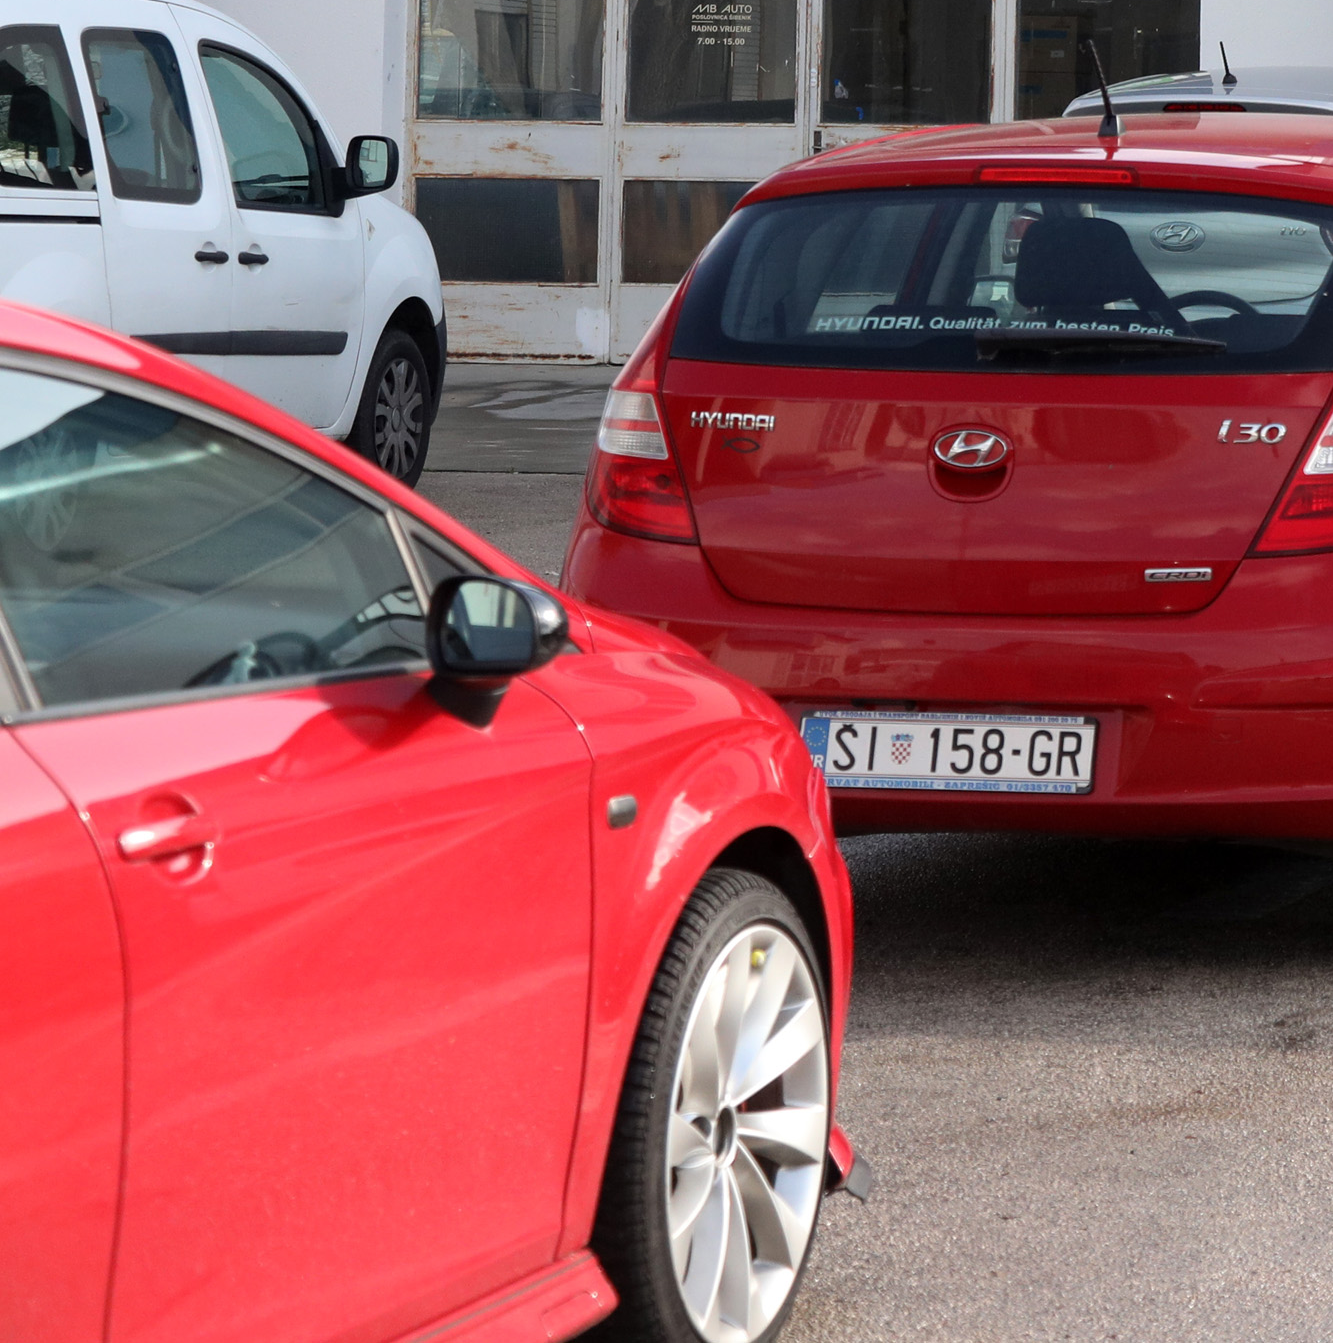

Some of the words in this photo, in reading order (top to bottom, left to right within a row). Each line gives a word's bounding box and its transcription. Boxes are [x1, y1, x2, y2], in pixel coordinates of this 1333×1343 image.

[692, 4, 718, 14] MB
[720, 4, 753, 14] AUTO
[691, 25, 718, 33] RADNO
[719, 25, 752, 33] VRIJEME
[697, 37, 716, 45] 7.00
[722, 37, 746, 46] 15.00
[929, 316, 1001, 331] Qualität
[1008, 321, 1048, 330] zum
[1055, 319, 1120, 332] besten
[1128, 323, 1175, 337] Preis
[690, 411, 775, 432] HYUNDAI
[832, 723, 878, 772] ŠI
[930, 727, 1083, 777] 158-GR
[862, 779, 934, 789] AUTOMOBILI
